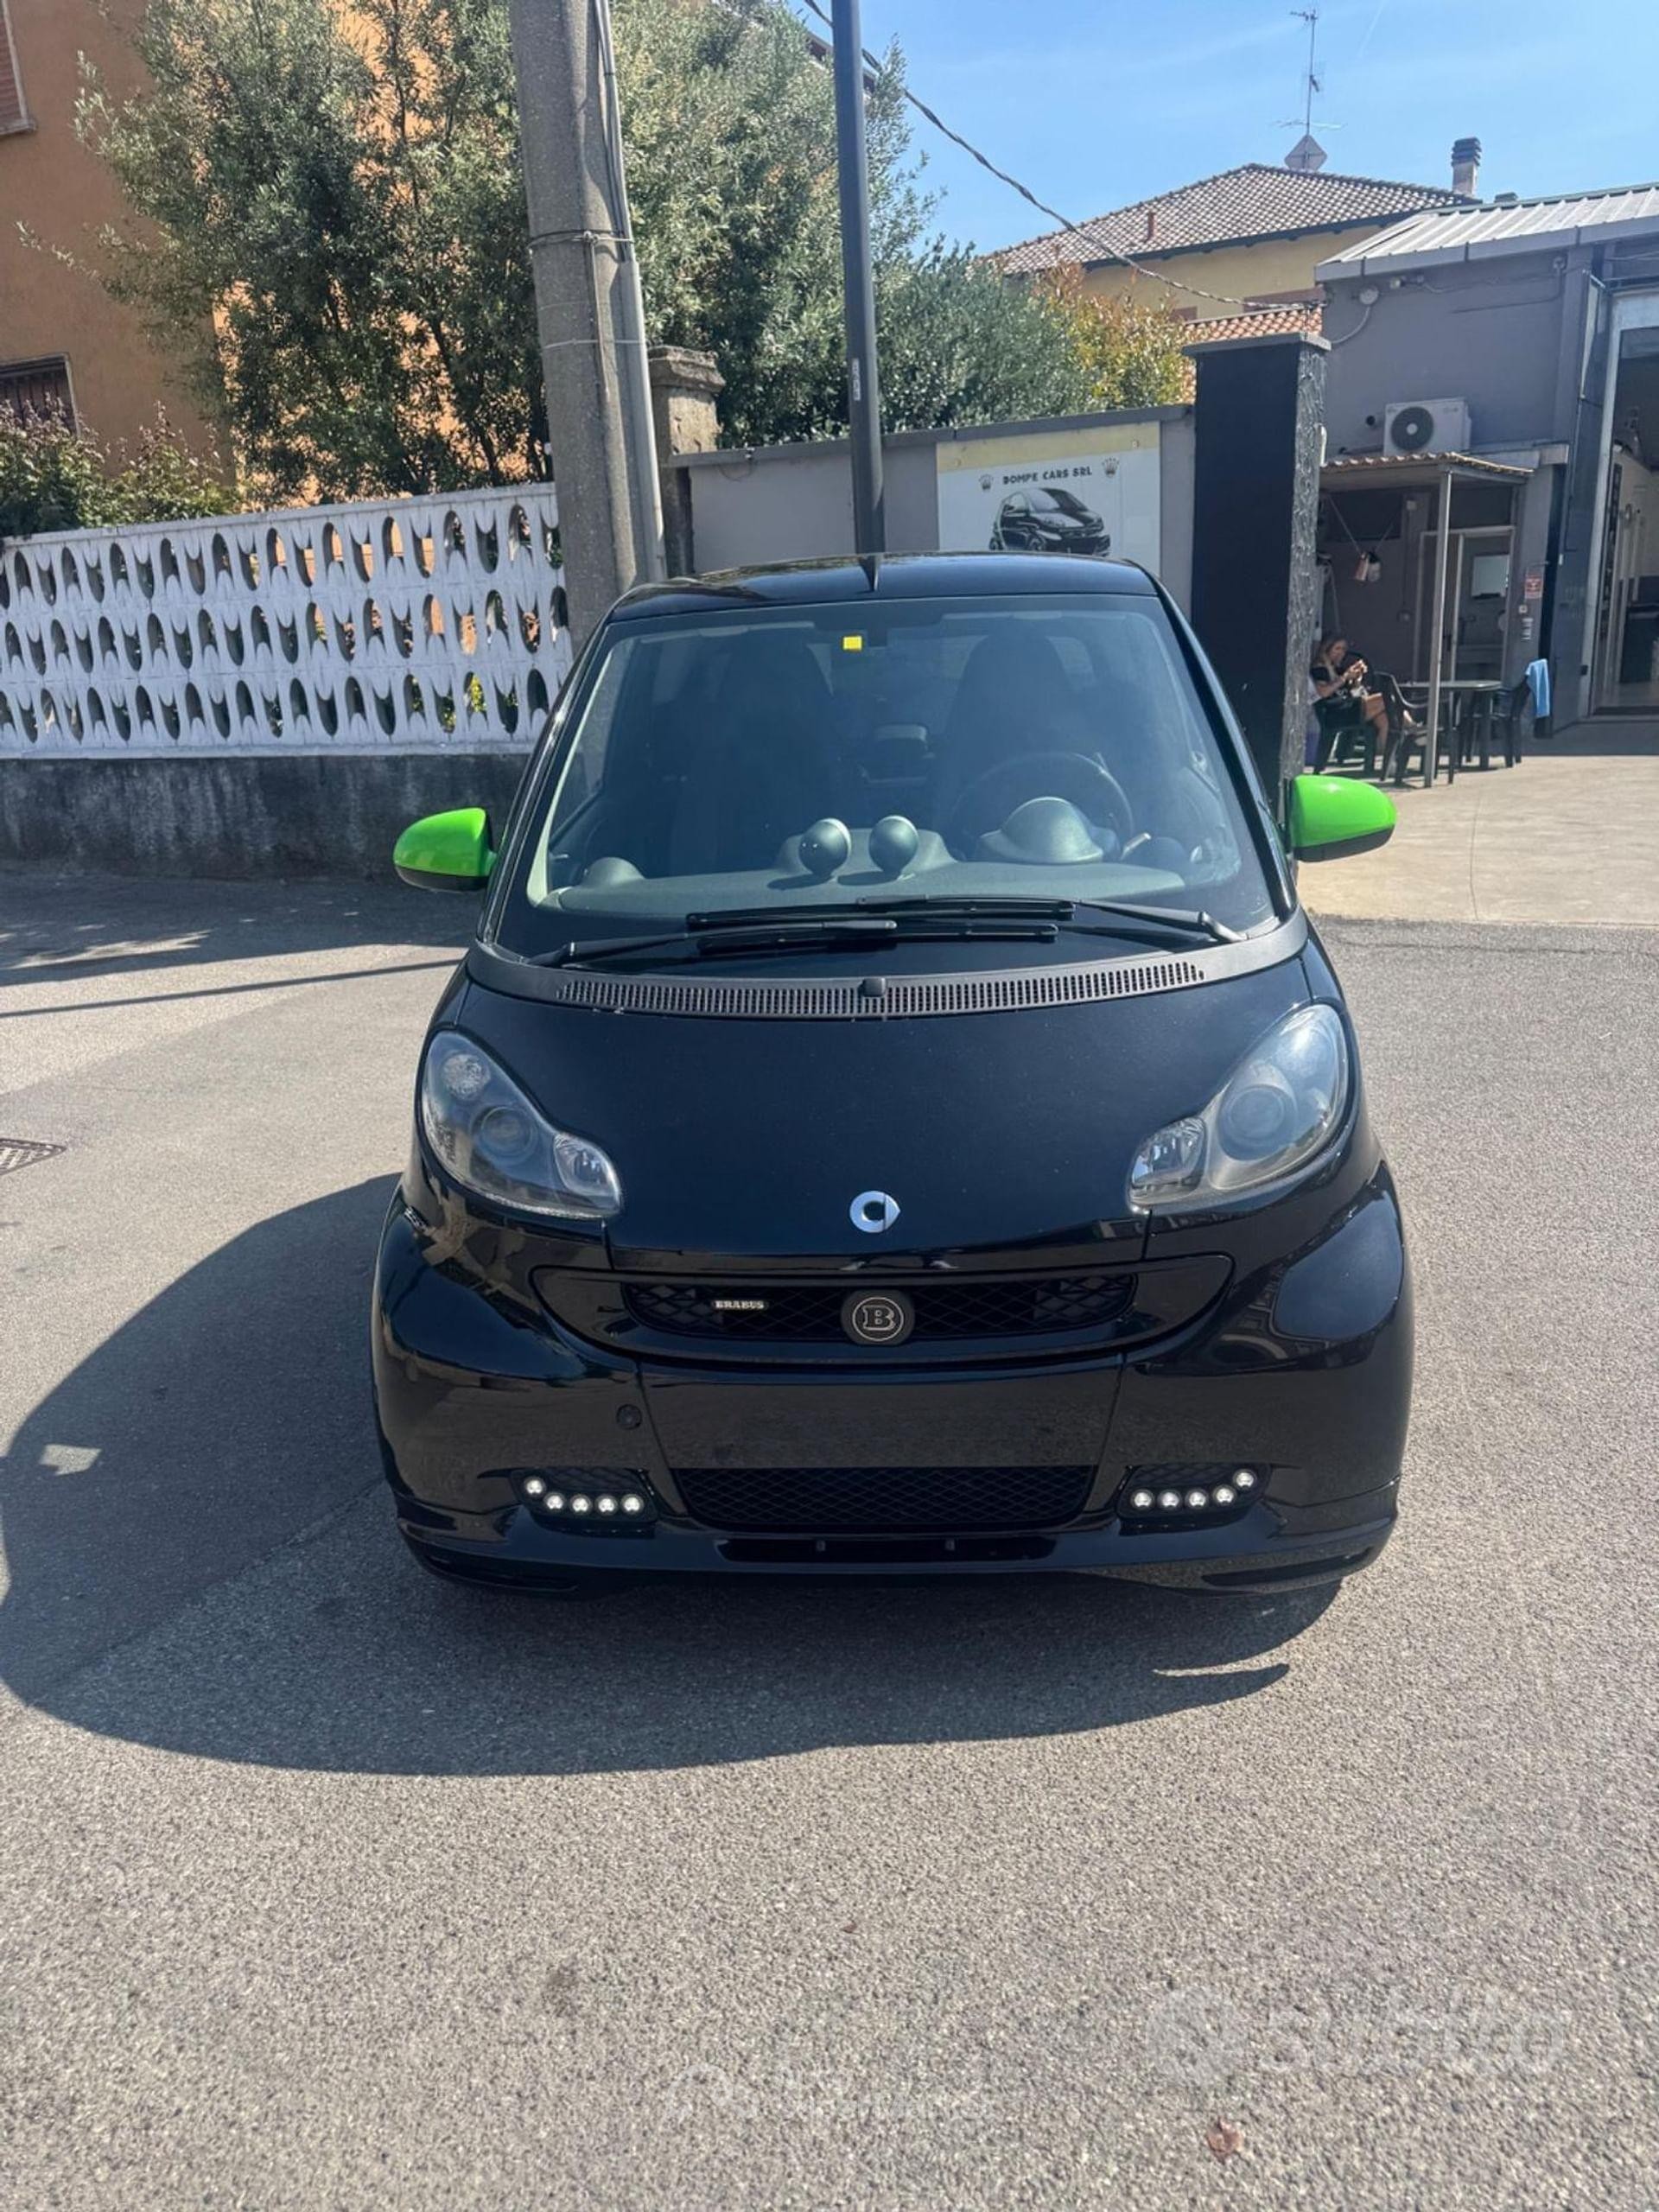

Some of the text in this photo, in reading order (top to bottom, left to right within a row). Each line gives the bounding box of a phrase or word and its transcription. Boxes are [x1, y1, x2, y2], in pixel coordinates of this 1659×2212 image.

[1003, 466, 1092, 485] BOMPE CARS SRL
[715, 1300, 765, 1310] BRABUS
[863, 1305, 895, 1331] B
